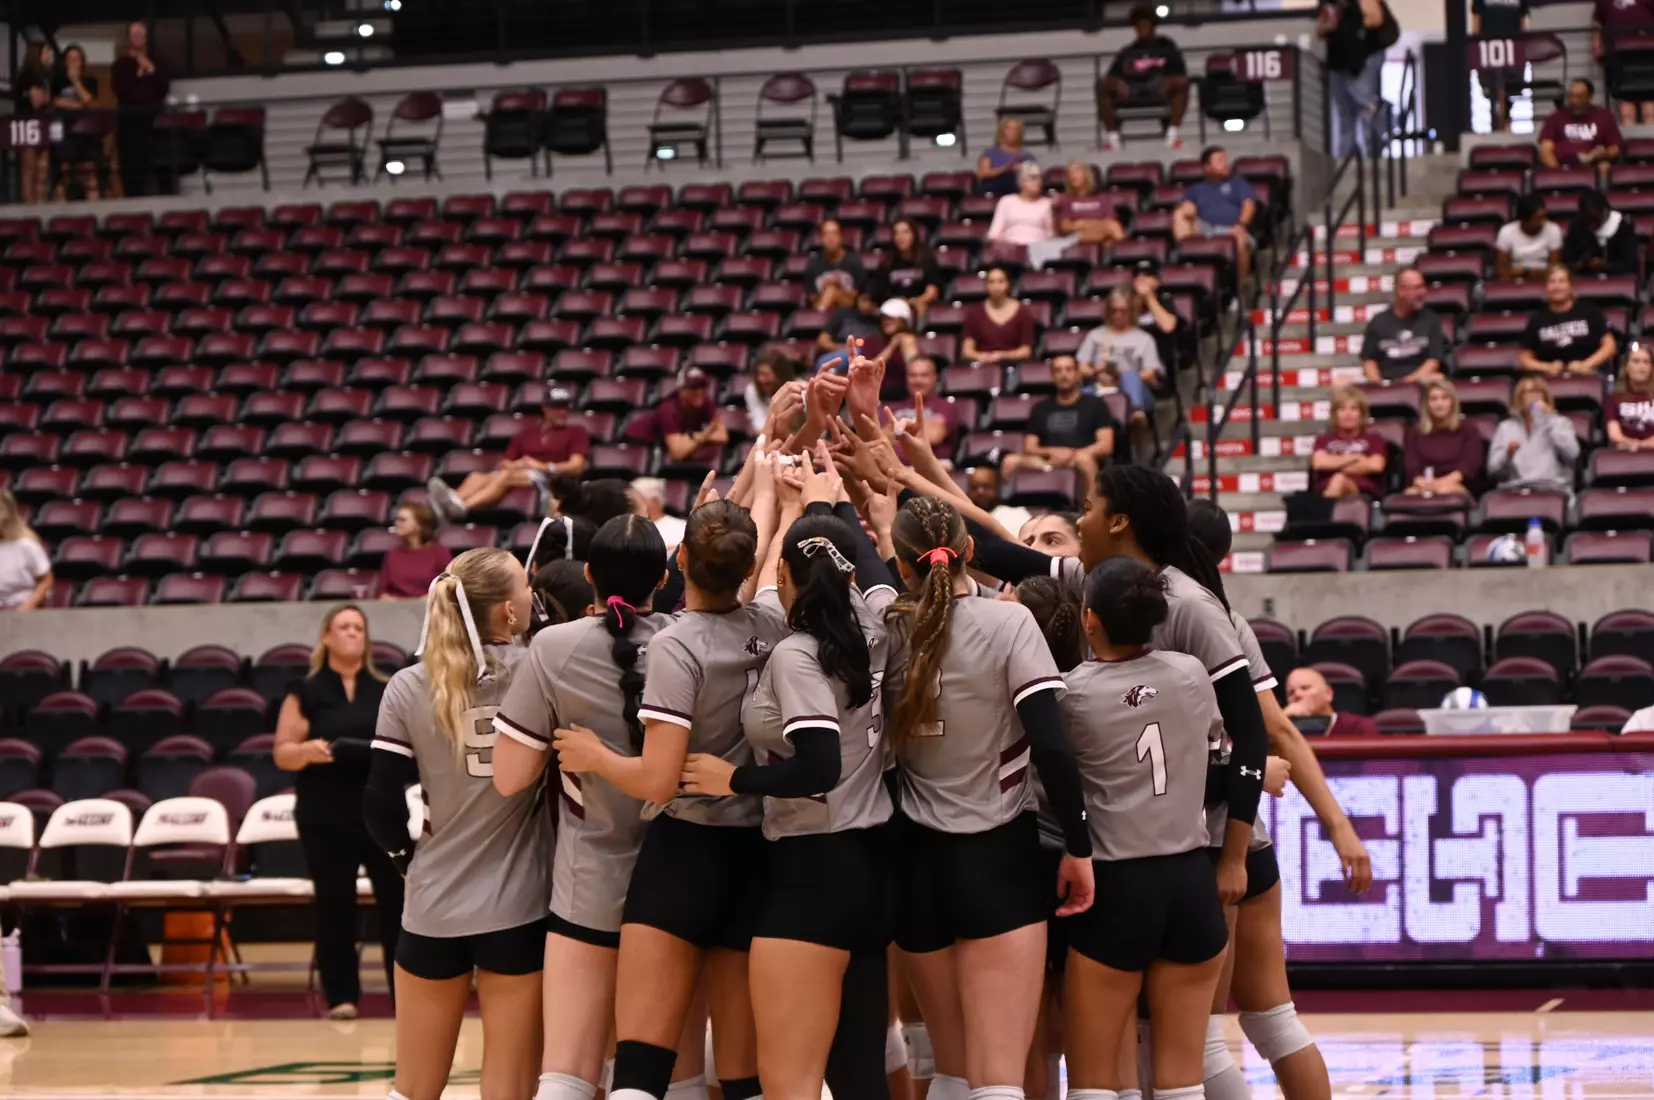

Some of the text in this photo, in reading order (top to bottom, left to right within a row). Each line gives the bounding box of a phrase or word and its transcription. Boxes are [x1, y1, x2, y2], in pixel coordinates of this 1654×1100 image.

[1245, 51, 1281, 79] 116
[1478, 38, 1515, 68] 101
[9, 119, 41, 147] 116
[1135, 721, 1168, 797] 1
